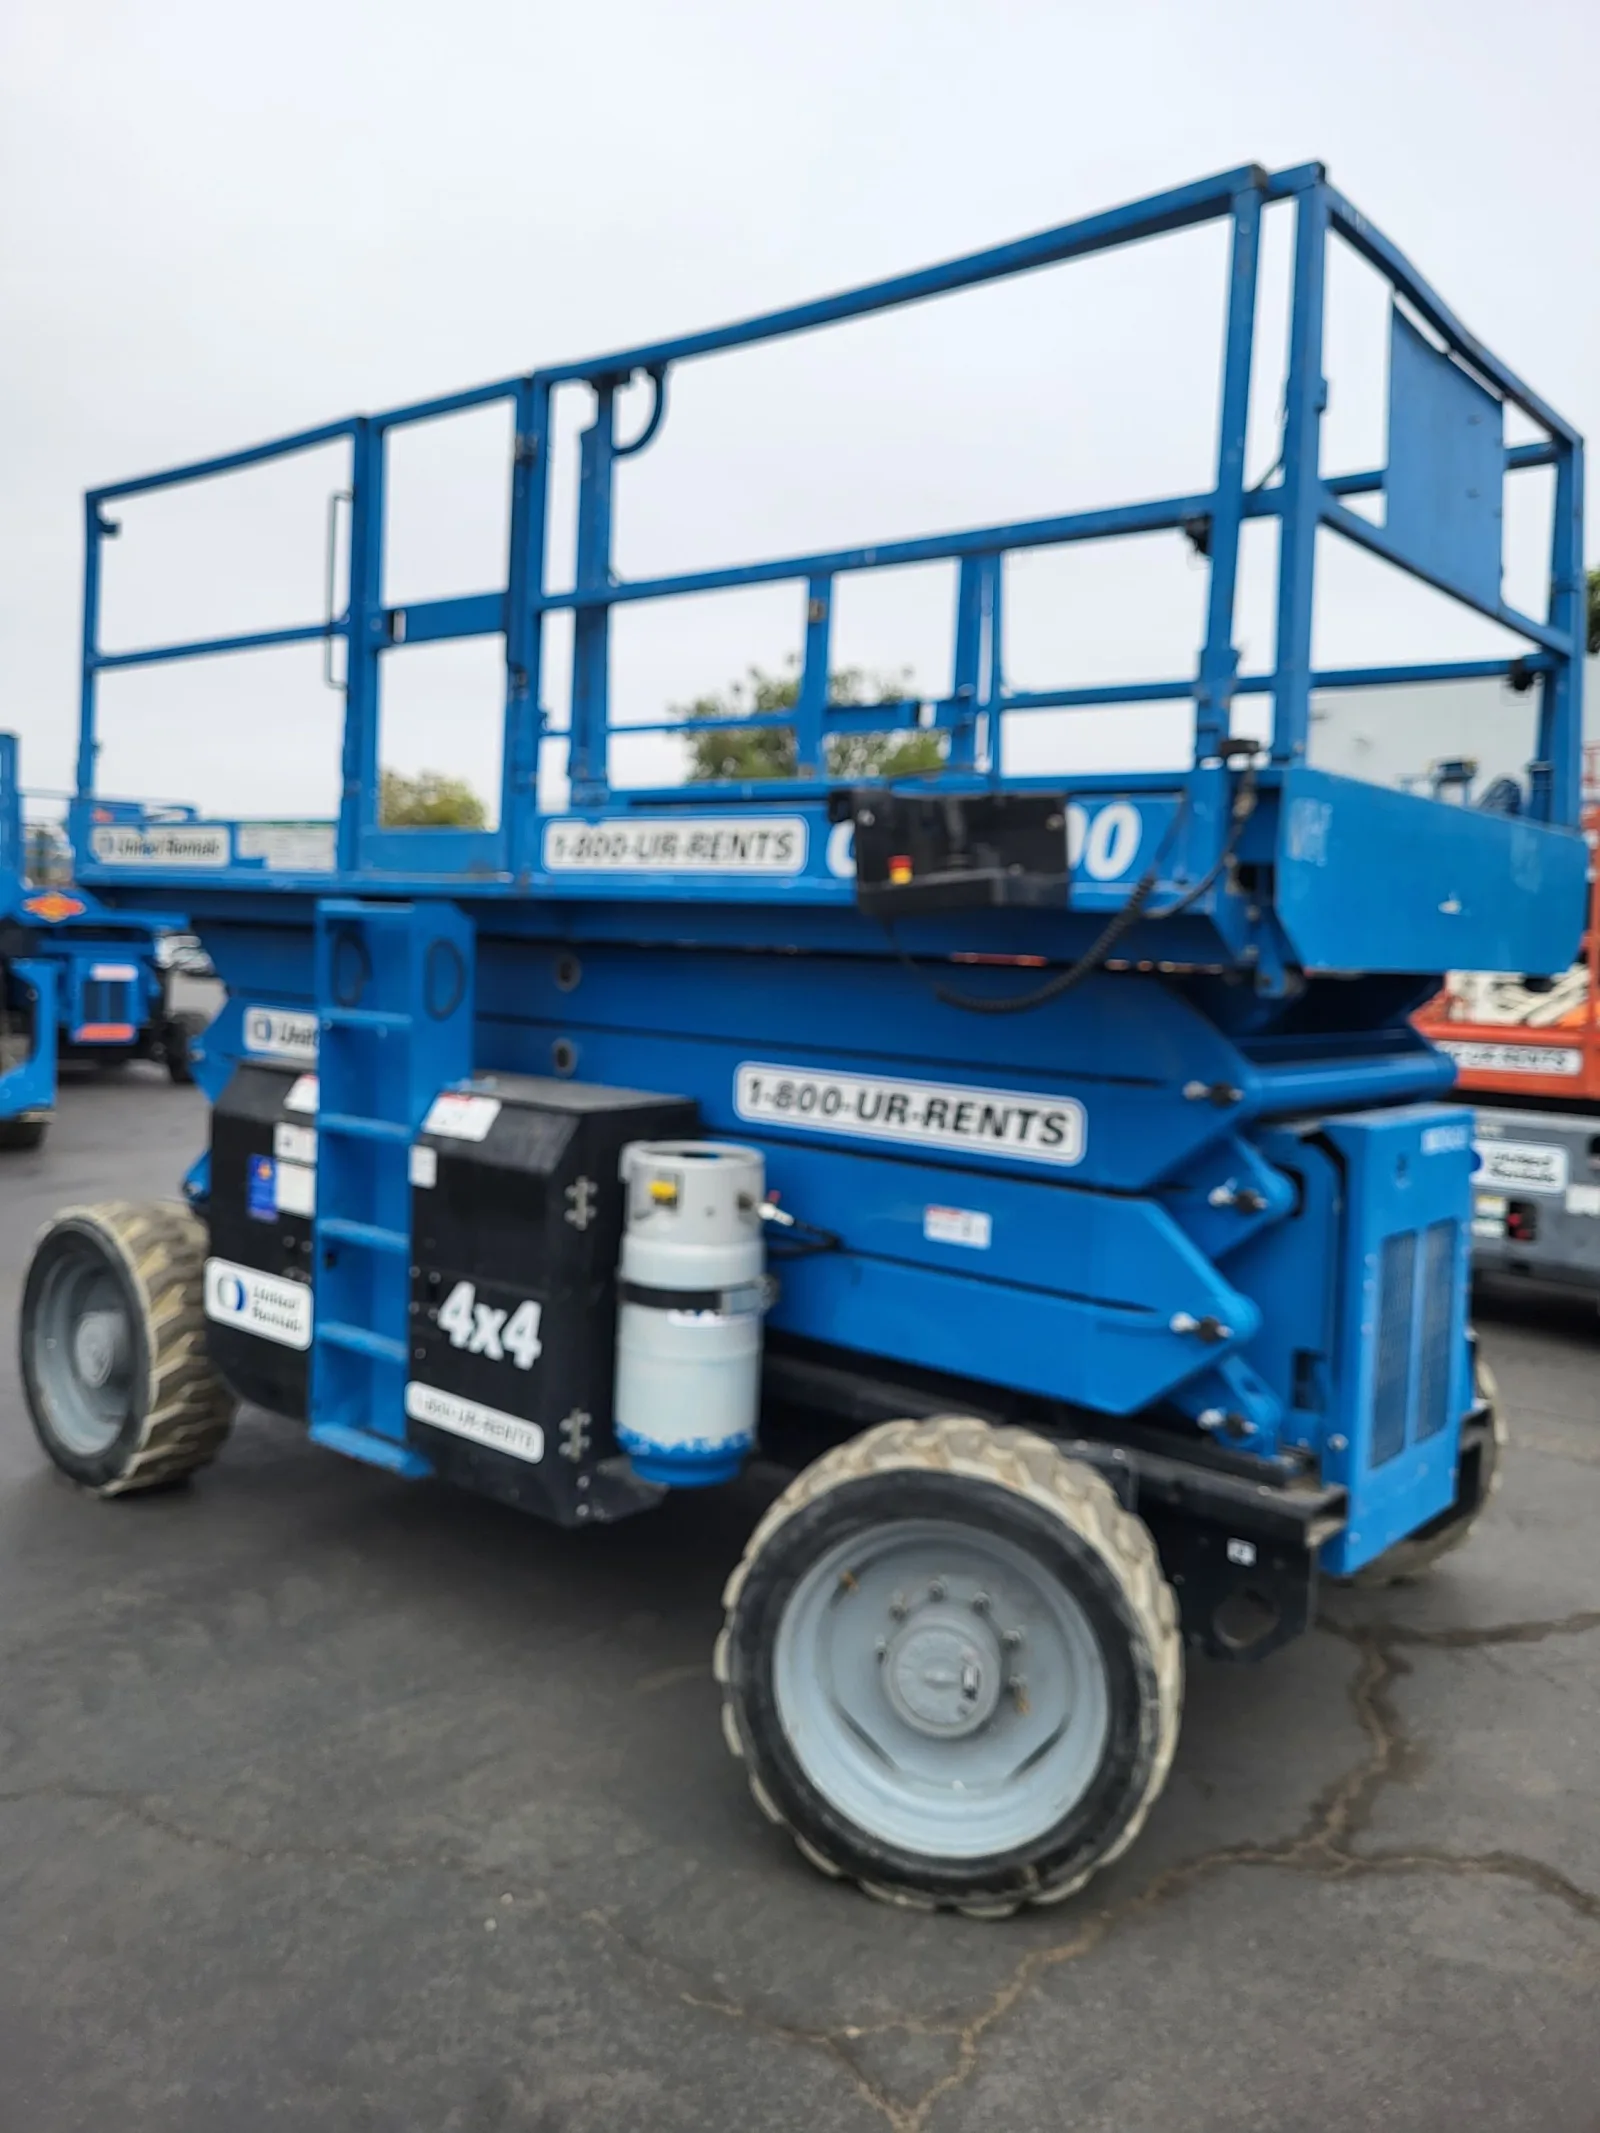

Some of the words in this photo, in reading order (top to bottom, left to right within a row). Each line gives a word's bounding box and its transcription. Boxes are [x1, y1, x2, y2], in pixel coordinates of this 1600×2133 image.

[553, 828, 796, 860] 1-800-UR-RENTS
[749, 1076, 1069, 1147] 1-800-UR-RENTS
[437, 1280, 542, 1371] 4x4
